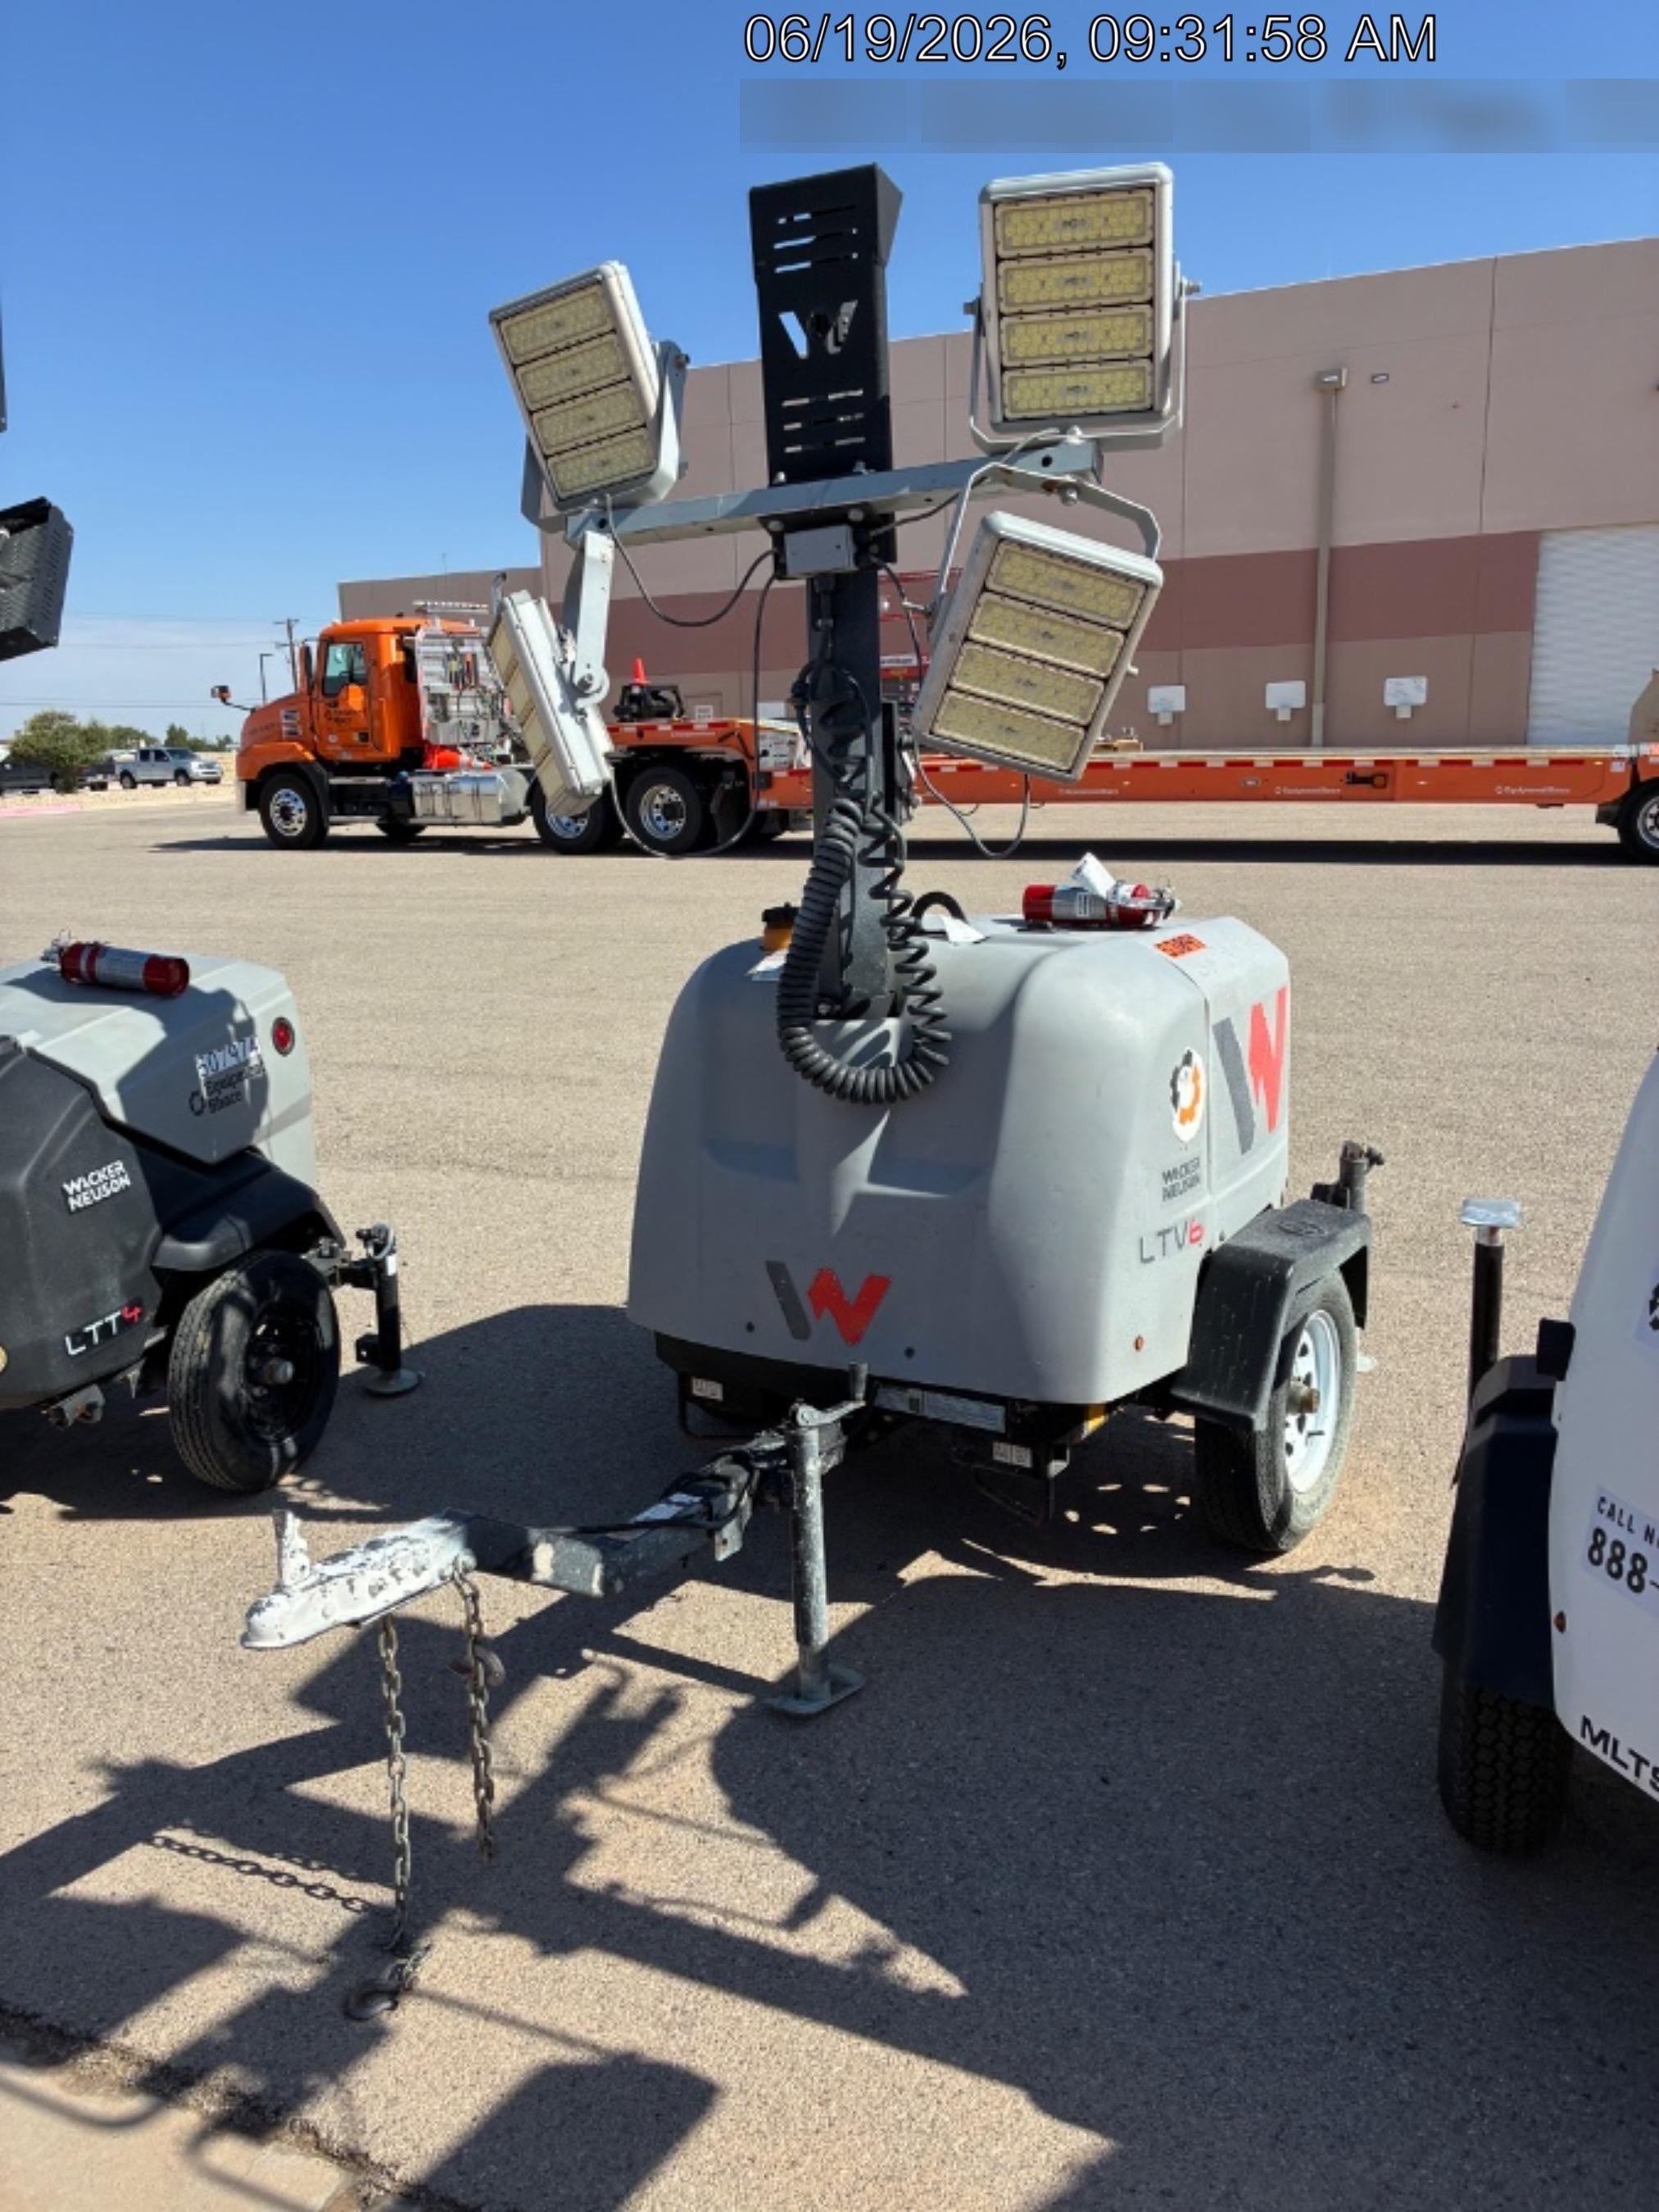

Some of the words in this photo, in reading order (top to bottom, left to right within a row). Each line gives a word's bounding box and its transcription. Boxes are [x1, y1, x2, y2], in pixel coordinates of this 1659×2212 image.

[62, 1159, 126, 1196] WACKER
[67, 1172, 131, 1213] NEUSON
[1140, 1217, 1205, 1264] LTV6
[65, 1304, 143, 1356] LTT4
[1597, 1495, 1636, 1534] CALL
[1643, 1523, 1659, 1551] N
